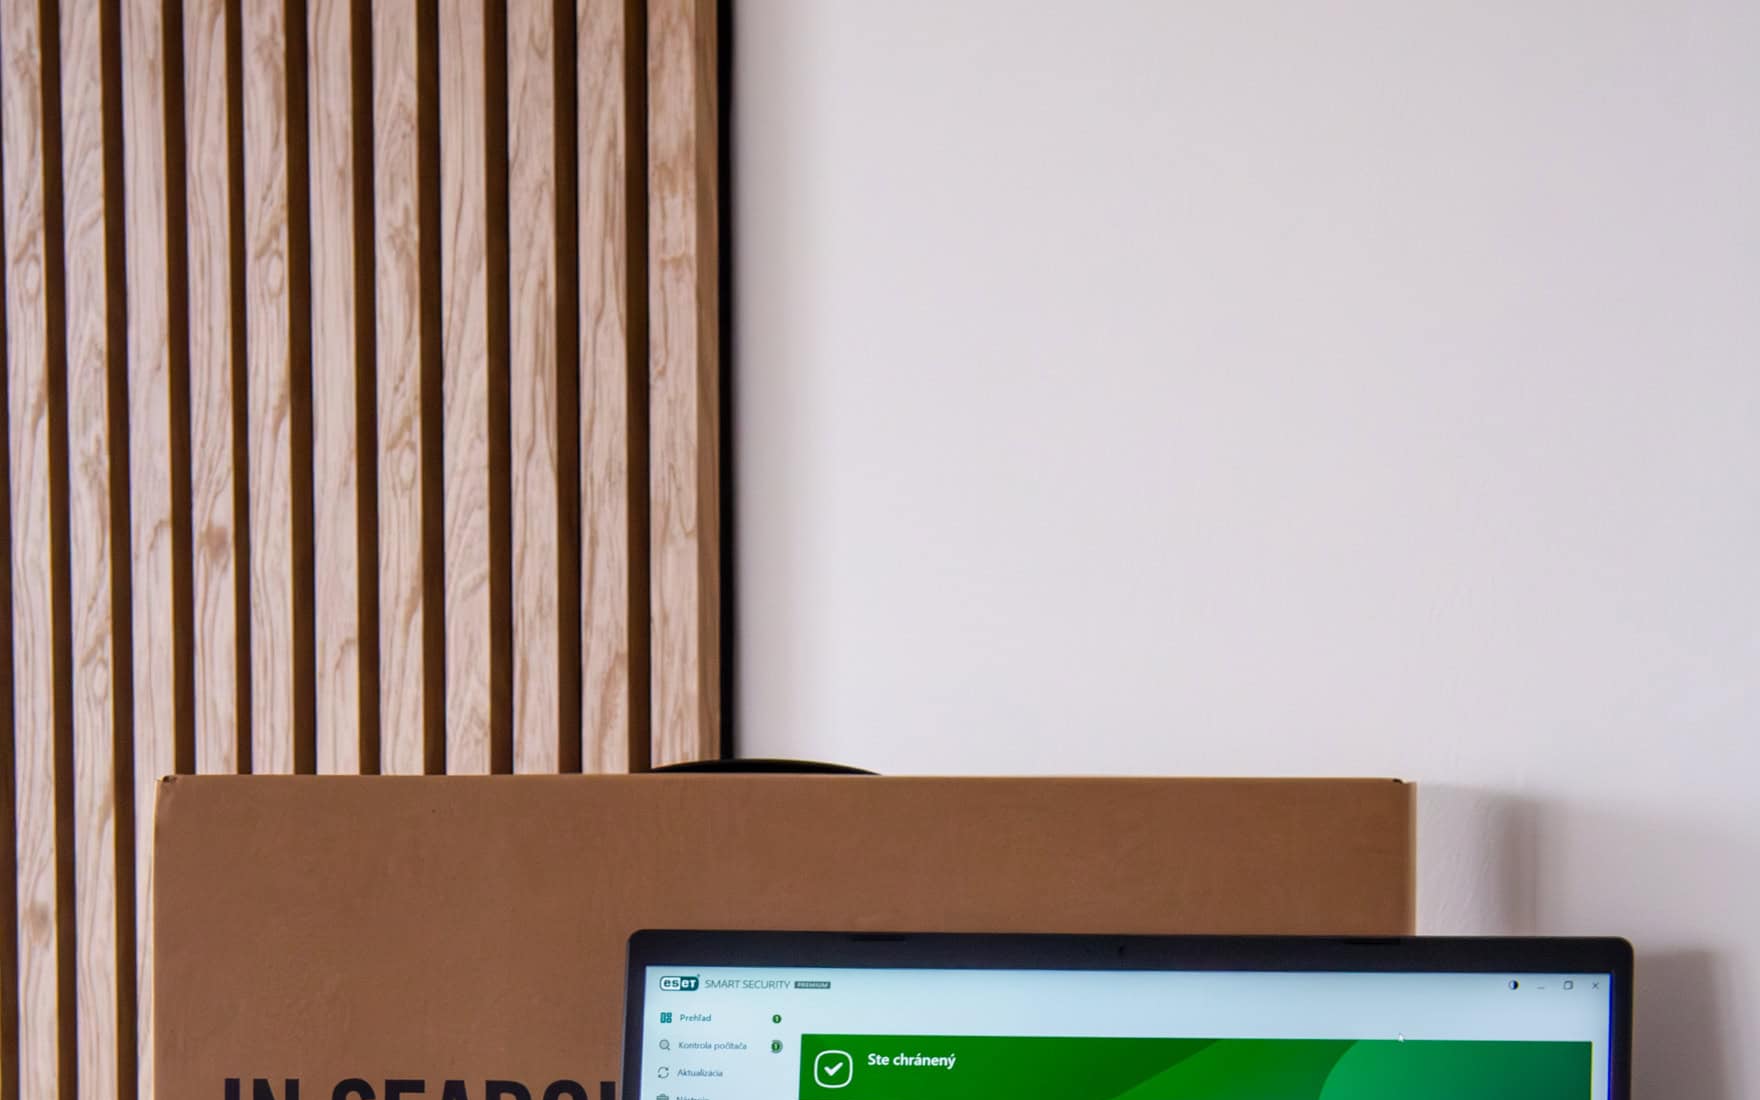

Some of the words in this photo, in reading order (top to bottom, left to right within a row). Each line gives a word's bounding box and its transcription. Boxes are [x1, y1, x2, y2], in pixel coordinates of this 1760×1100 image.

[705, 980, 740, 989] SMART
[743, 980, 790, 989] SECURITY
[678, 1041, 712, 1049] Kontrola
[868, 1053, 890, 1066] Ste
[894, 1052, 956, 1070] chránený
